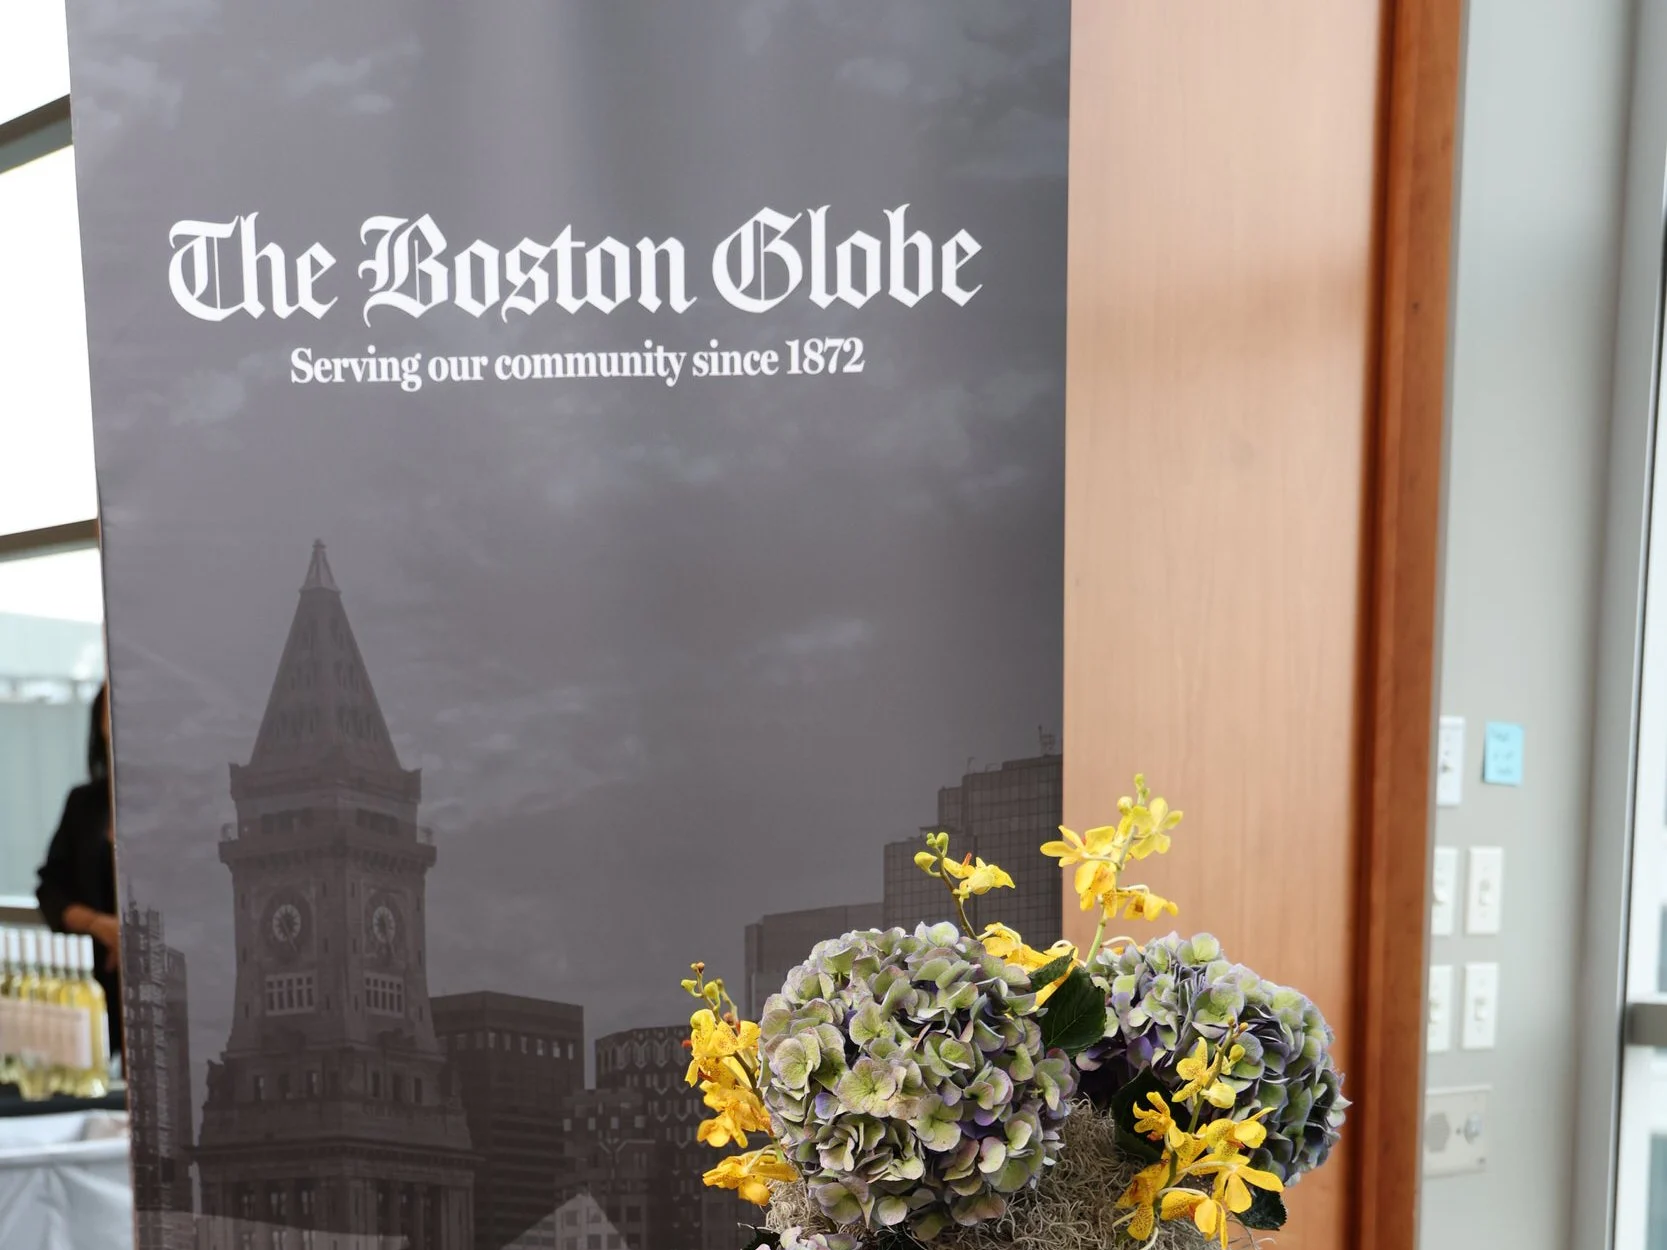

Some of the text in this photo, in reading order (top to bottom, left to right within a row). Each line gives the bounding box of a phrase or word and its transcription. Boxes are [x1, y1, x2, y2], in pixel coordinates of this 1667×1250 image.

[168, 203, 983, 328] The Boston Globe
[290, 336, 866, 393] Serving our community since 1872
